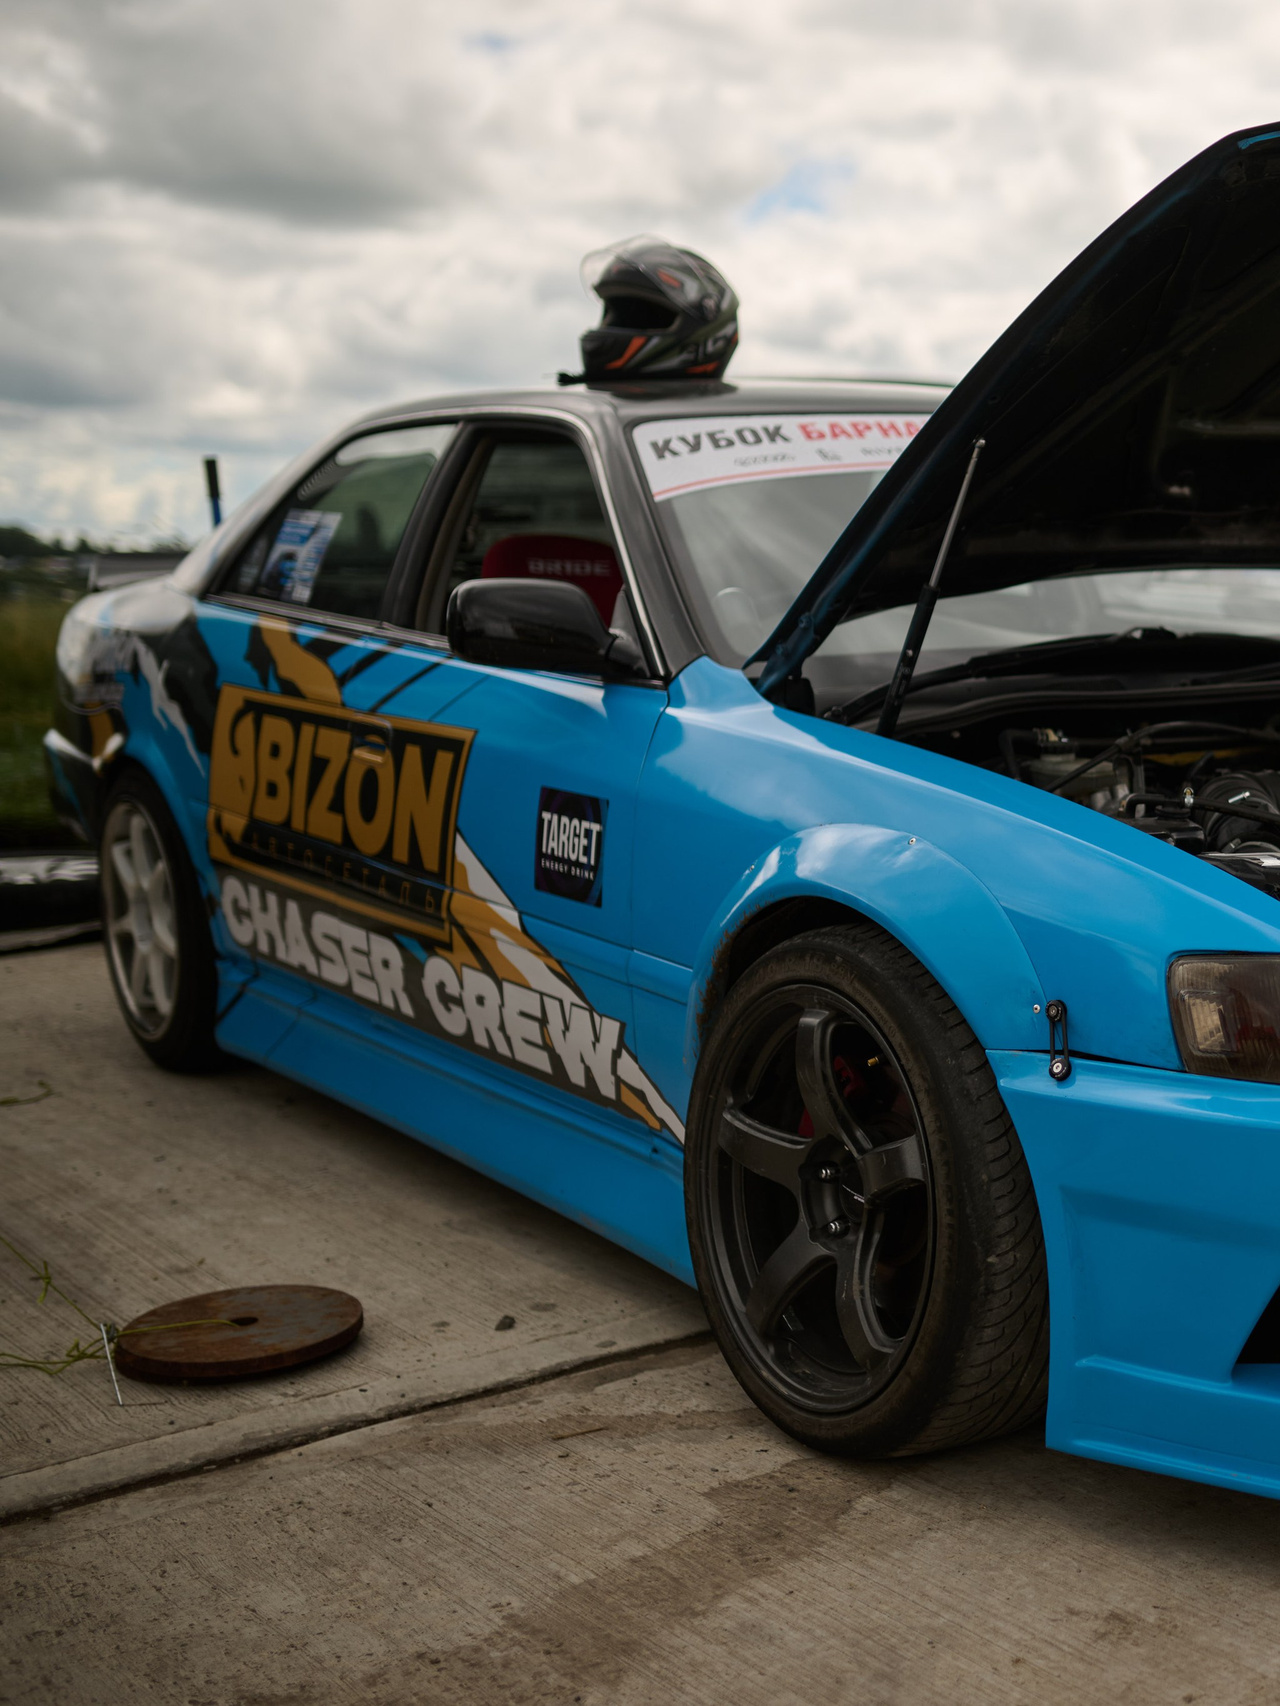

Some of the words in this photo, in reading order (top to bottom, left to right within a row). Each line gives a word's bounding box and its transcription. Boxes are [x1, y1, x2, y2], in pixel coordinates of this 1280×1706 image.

[650, 423, 791, 461] КУБОК
[527, 558, 611, 577] BRIDE
[253, 713, 454, 874] BIZON
[541, 810, 602, 866] TARGET
[541, 858, 568, 874] ENERGY
[571, 866, 594, 880] DRINK
[221, 875, 415, 1019] CHASER
[422, 955, 621, 1101] CREW
